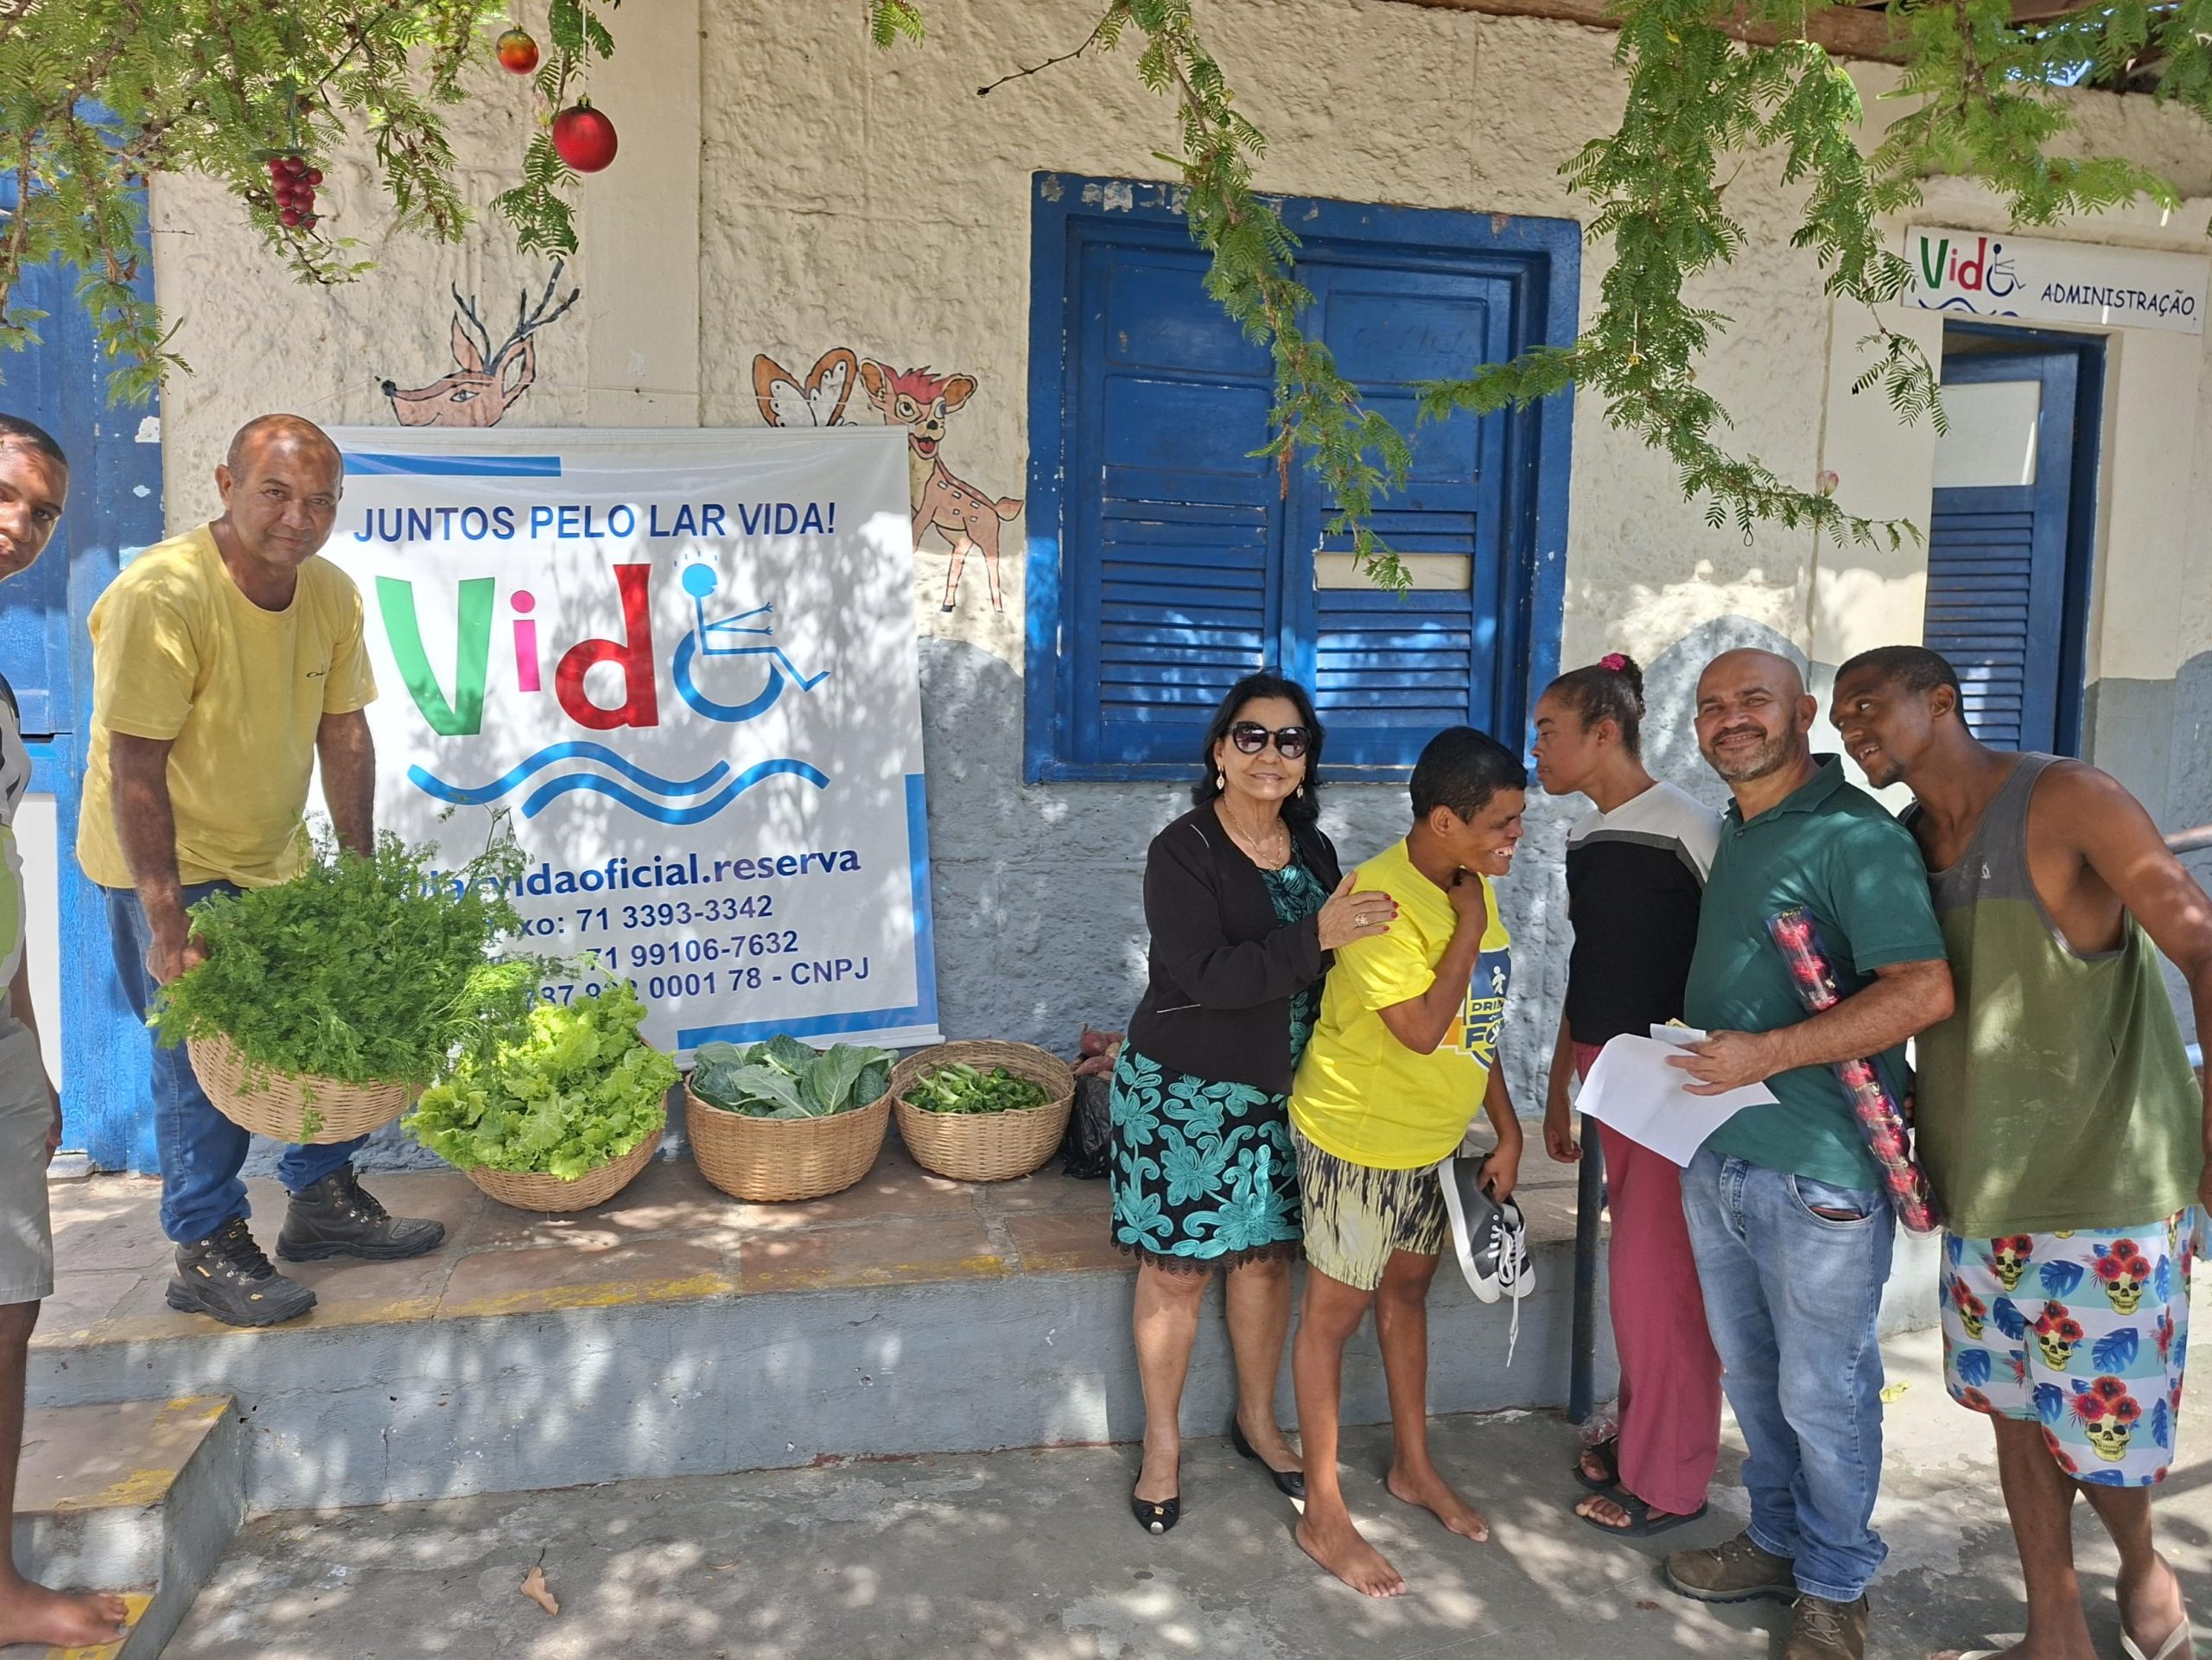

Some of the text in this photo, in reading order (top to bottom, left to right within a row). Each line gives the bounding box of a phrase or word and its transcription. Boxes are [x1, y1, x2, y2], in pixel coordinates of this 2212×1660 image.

[2040, 283, 2196, 317] ADMINISTRAÇÃO
[353, 501, 836, 543] JUNTOS PELO LAR VIDA!
[400, 849, 861, 901] lavidaoficial.reserva
[575, 907, 609, 932] 71
[621, 894, 773, 929] 3393-3342
[585, 945, 618, 971] 71
[630, 930, 799, 969] 99106-7632
[649, 971, 716, 999] 0001
[728, 967, 762, 991] 78
[791, 957, 870, 985] CNPJ
